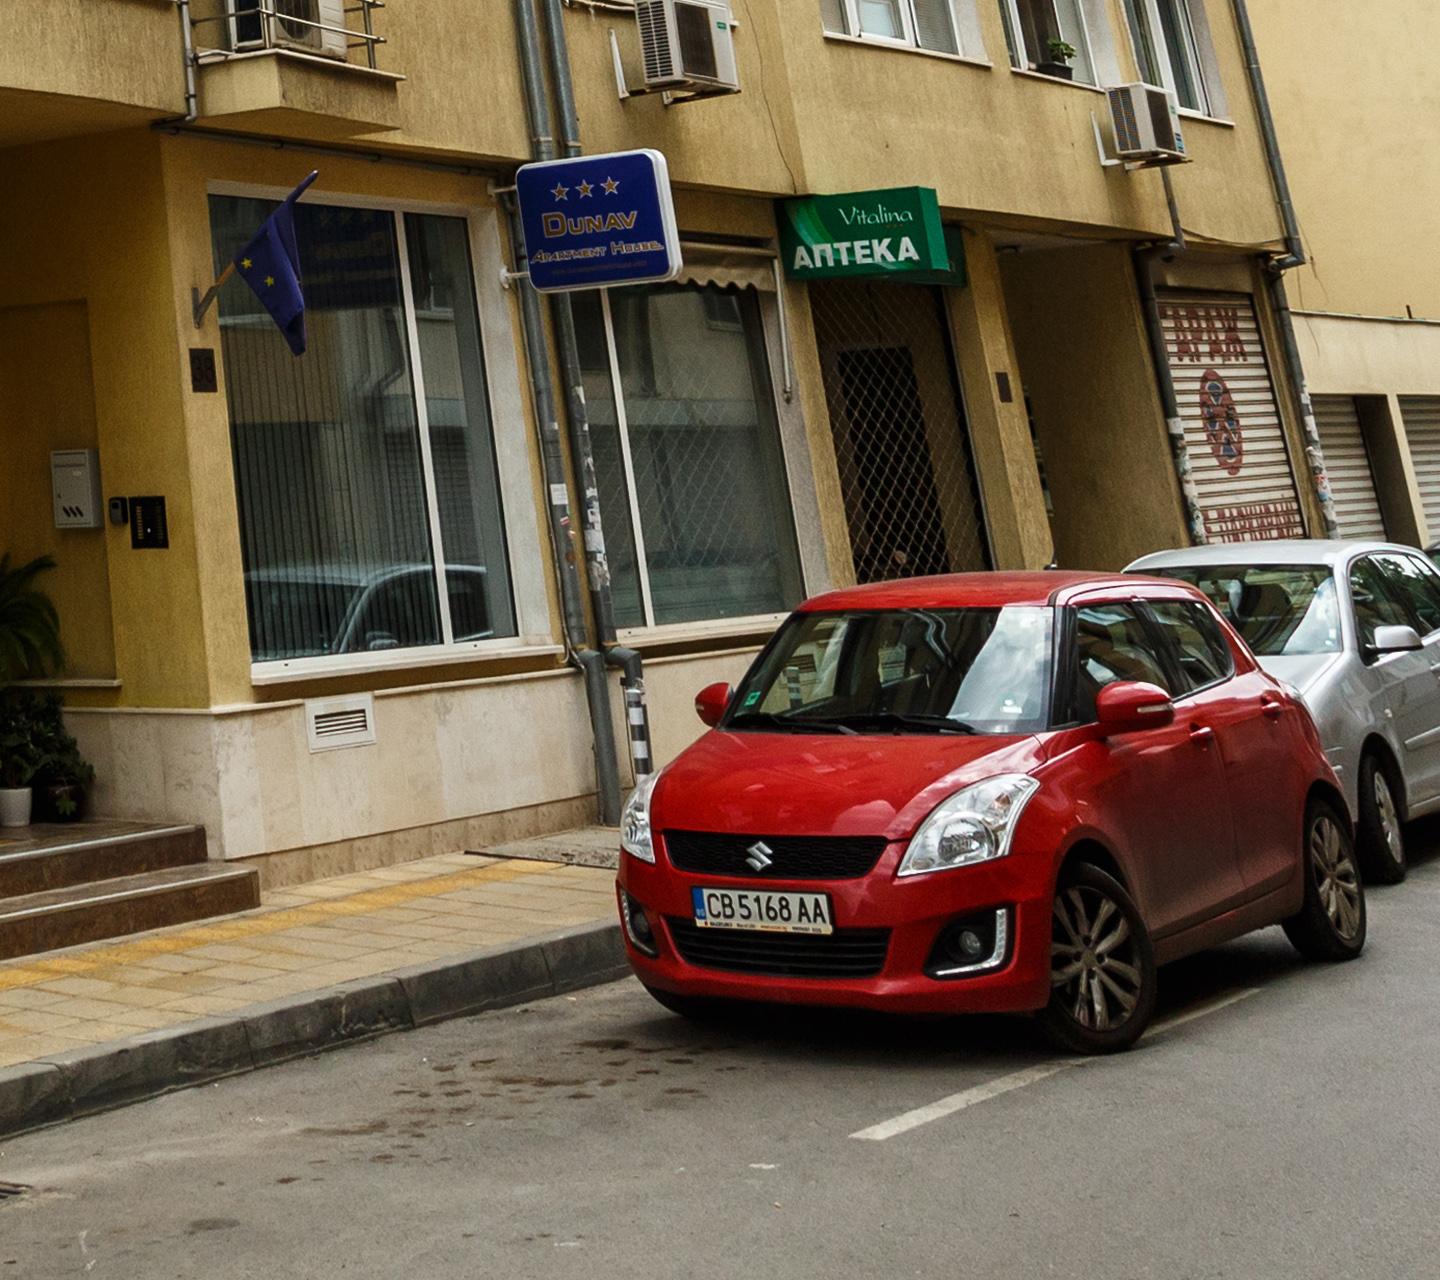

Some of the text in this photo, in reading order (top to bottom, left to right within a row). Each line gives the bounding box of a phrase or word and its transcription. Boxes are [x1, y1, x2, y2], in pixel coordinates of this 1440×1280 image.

[541, 210, 638, 239] DUNAV
[838, 203, 914, 226] Vitalina
[793, 236, 921, 270] АПТЕКА
[707, 893, 826, 924] CB 5168 AA
